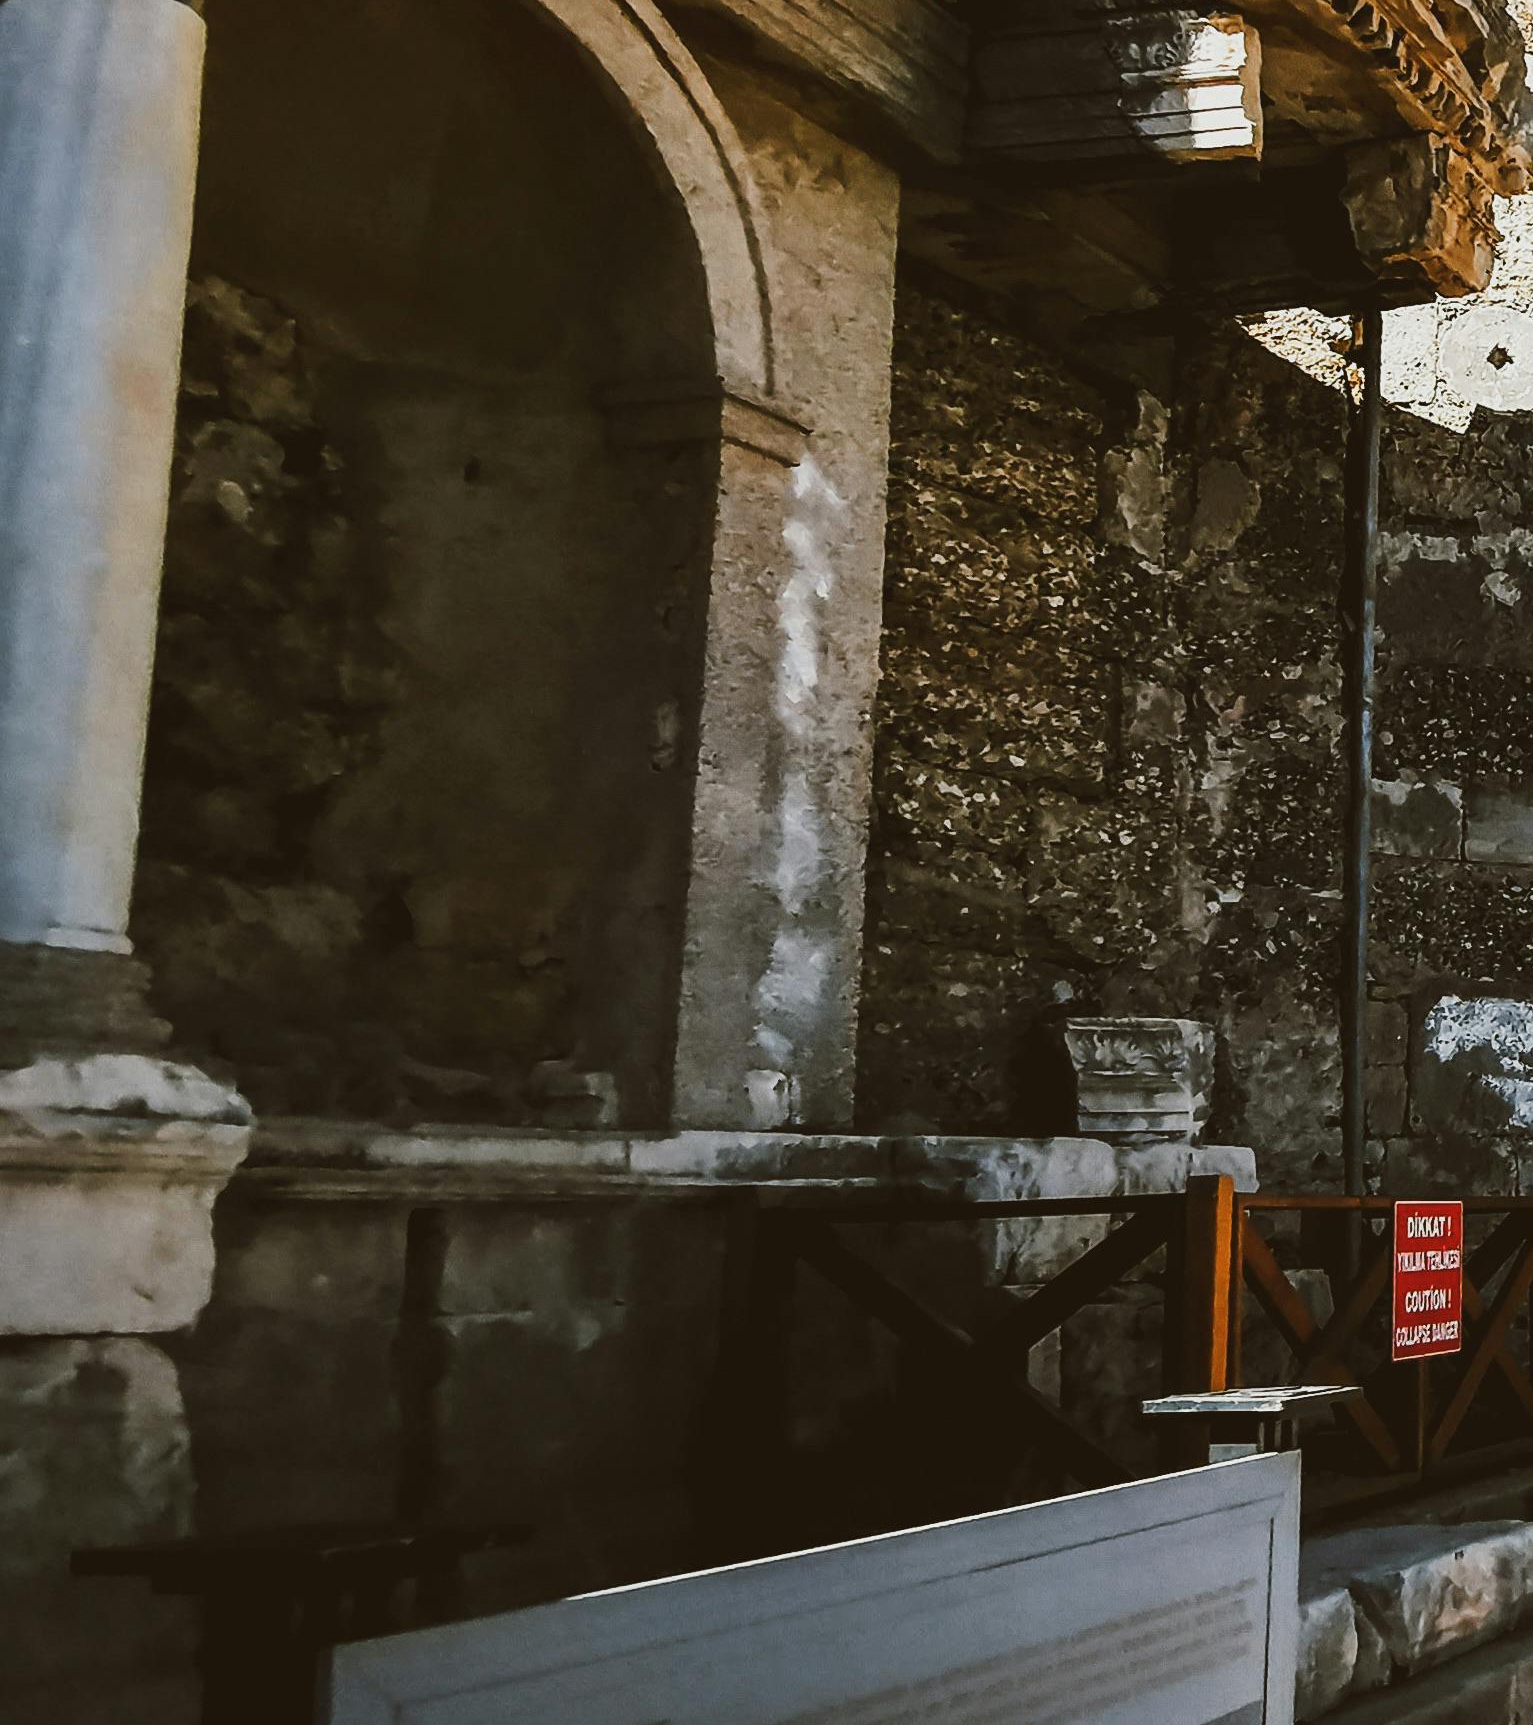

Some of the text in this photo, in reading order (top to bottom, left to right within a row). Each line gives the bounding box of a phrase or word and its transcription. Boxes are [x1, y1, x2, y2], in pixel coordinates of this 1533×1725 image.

[1407, 1212, 1445, 1238] DİKKAT
[1396, 1320, 1458, 1347] COLLAPSE DANGER
